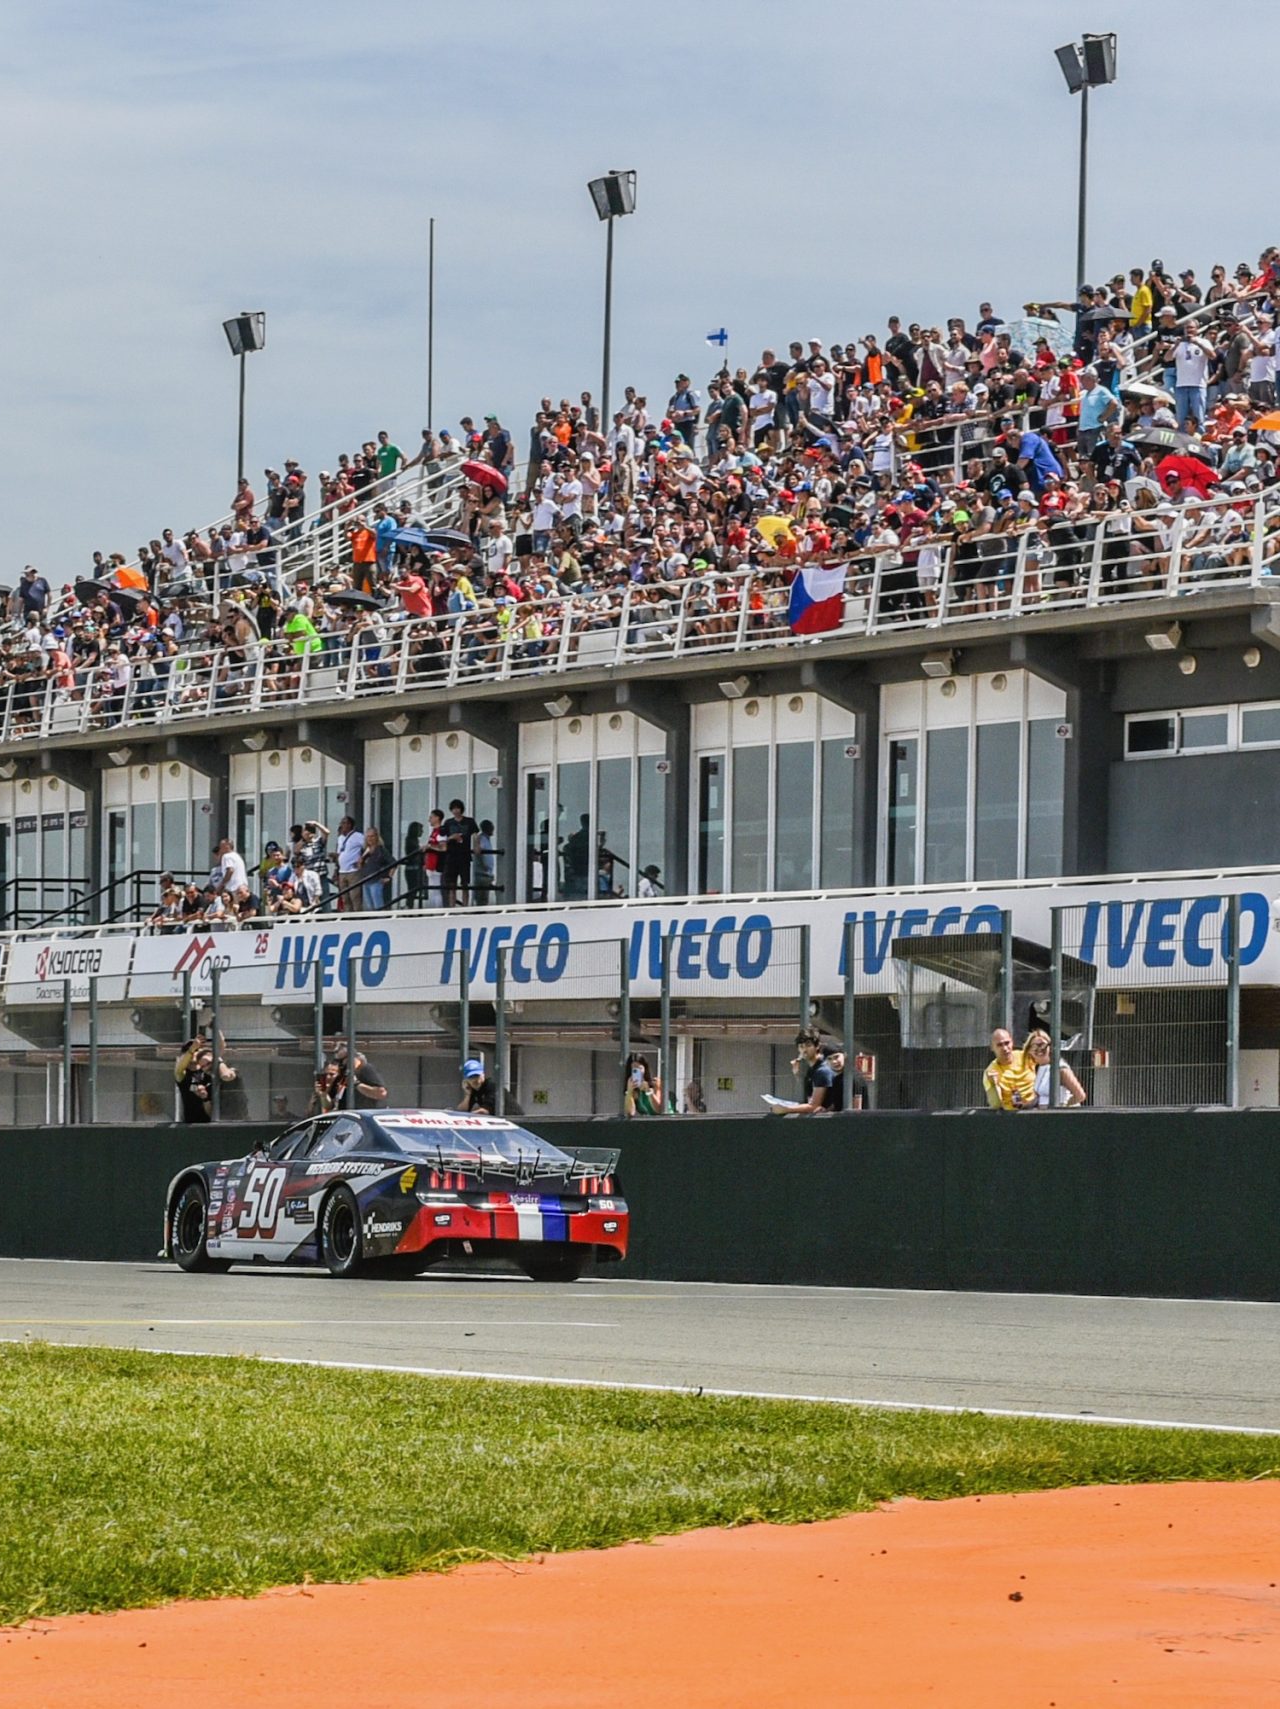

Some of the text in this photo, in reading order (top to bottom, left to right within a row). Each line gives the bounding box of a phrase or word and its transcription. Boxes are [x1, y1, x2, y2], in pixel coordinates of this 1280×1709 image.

[1079, 892, 1269, 968] IVECO
[255, 933, 269, 954] 25
[441, 922, 570, 983] IVECO
[628, 914, 773, 980] IVECO
[49, 949, 102, 975] KYOCERA
[276, 930, 390, 988] IVECO
[405, 1117, 481, 1126] WHELEN
[340, 1161, 384, 1176] SYSTEMS
[238, 1168, 287, 1228] 50
[599, 1199, 614, 1210] 50
[371, 1221, 402, 1233] HENDRIKS
